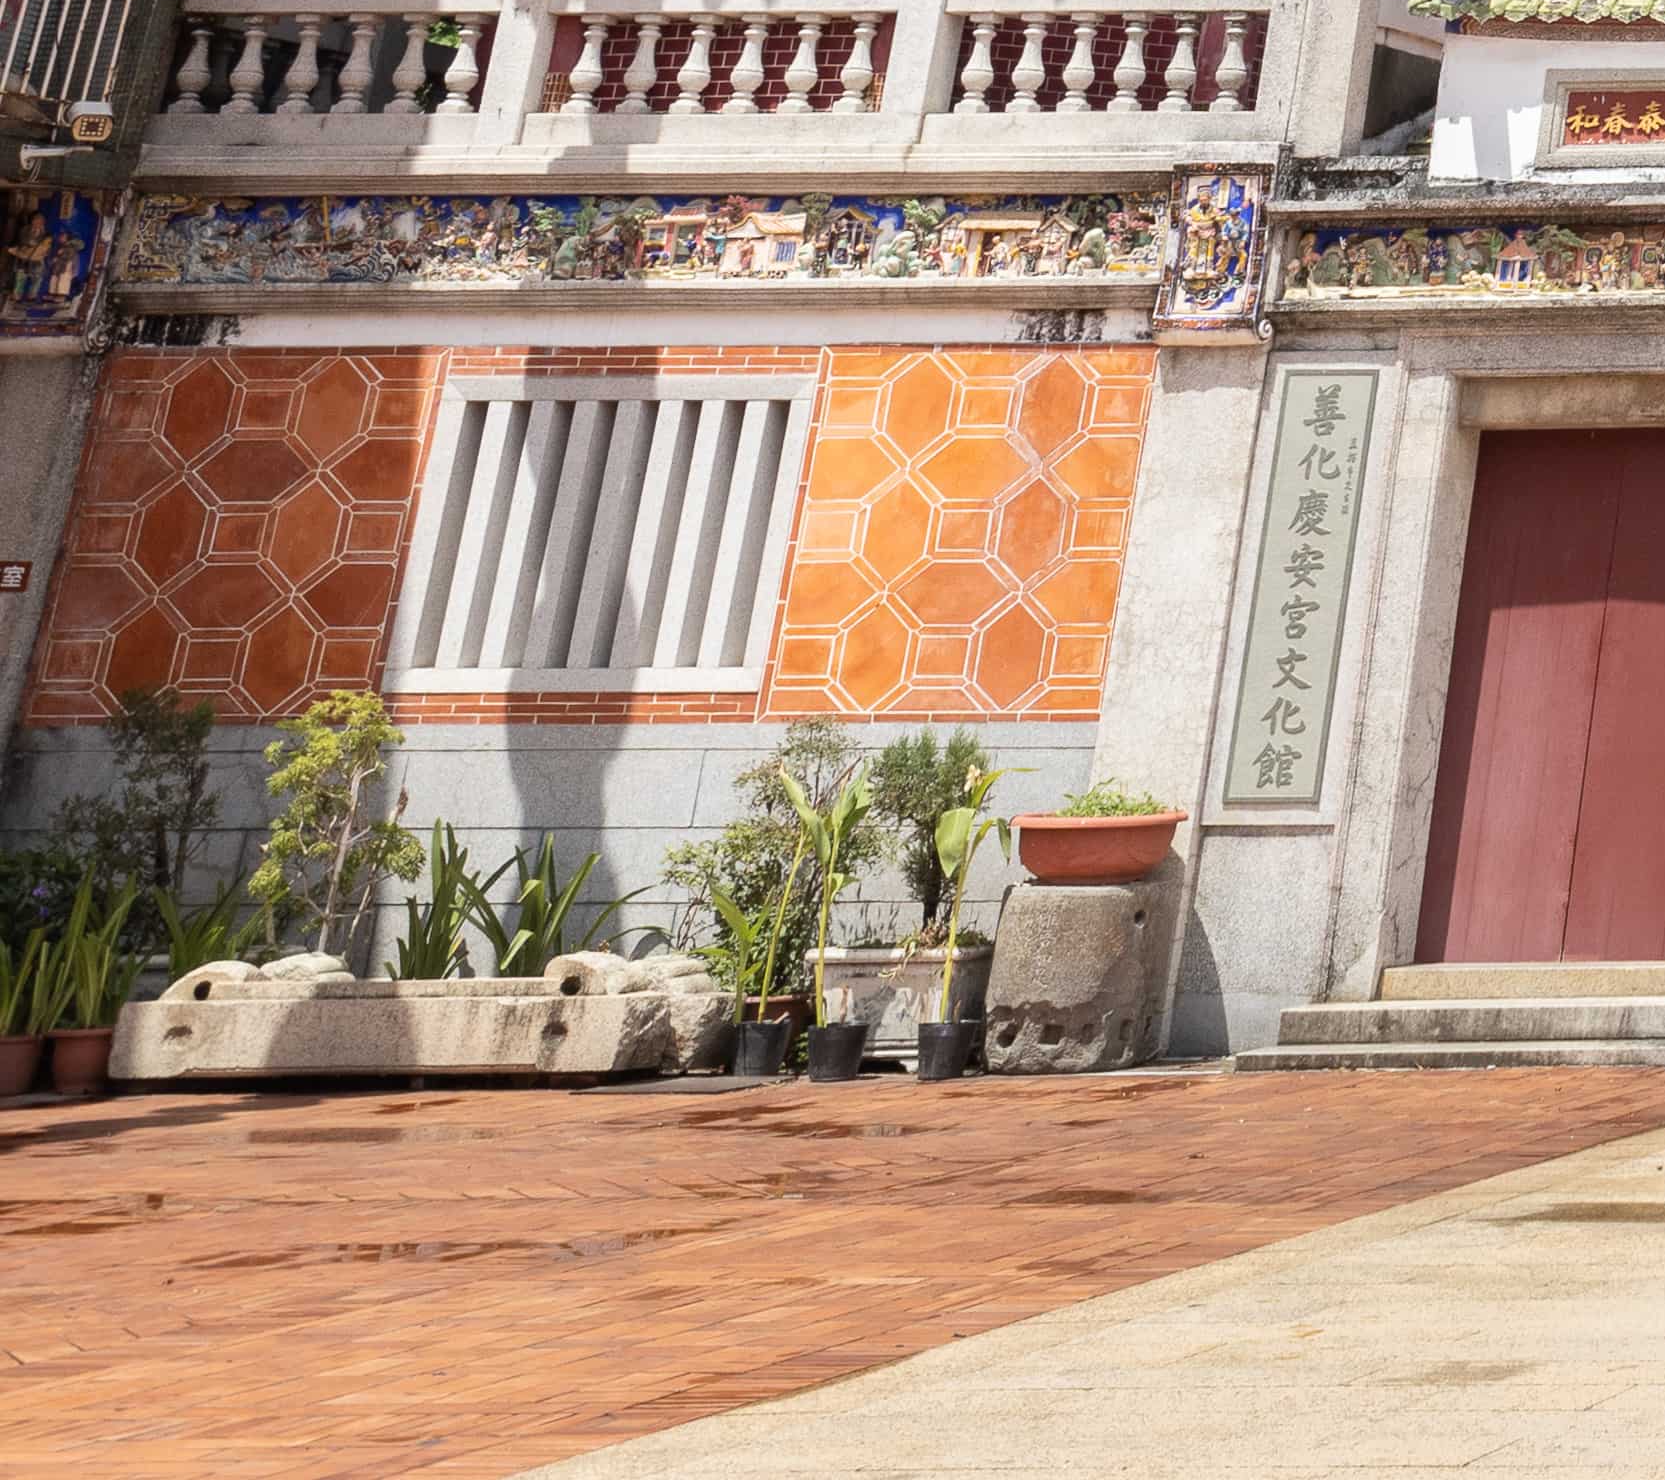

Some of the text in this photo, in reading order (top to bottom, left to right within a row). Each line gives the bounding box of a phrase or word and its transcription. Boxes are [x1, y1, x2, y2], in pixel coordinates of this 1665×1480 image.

[1252, 383, 1347, 790] 善化慶安宮文化館
